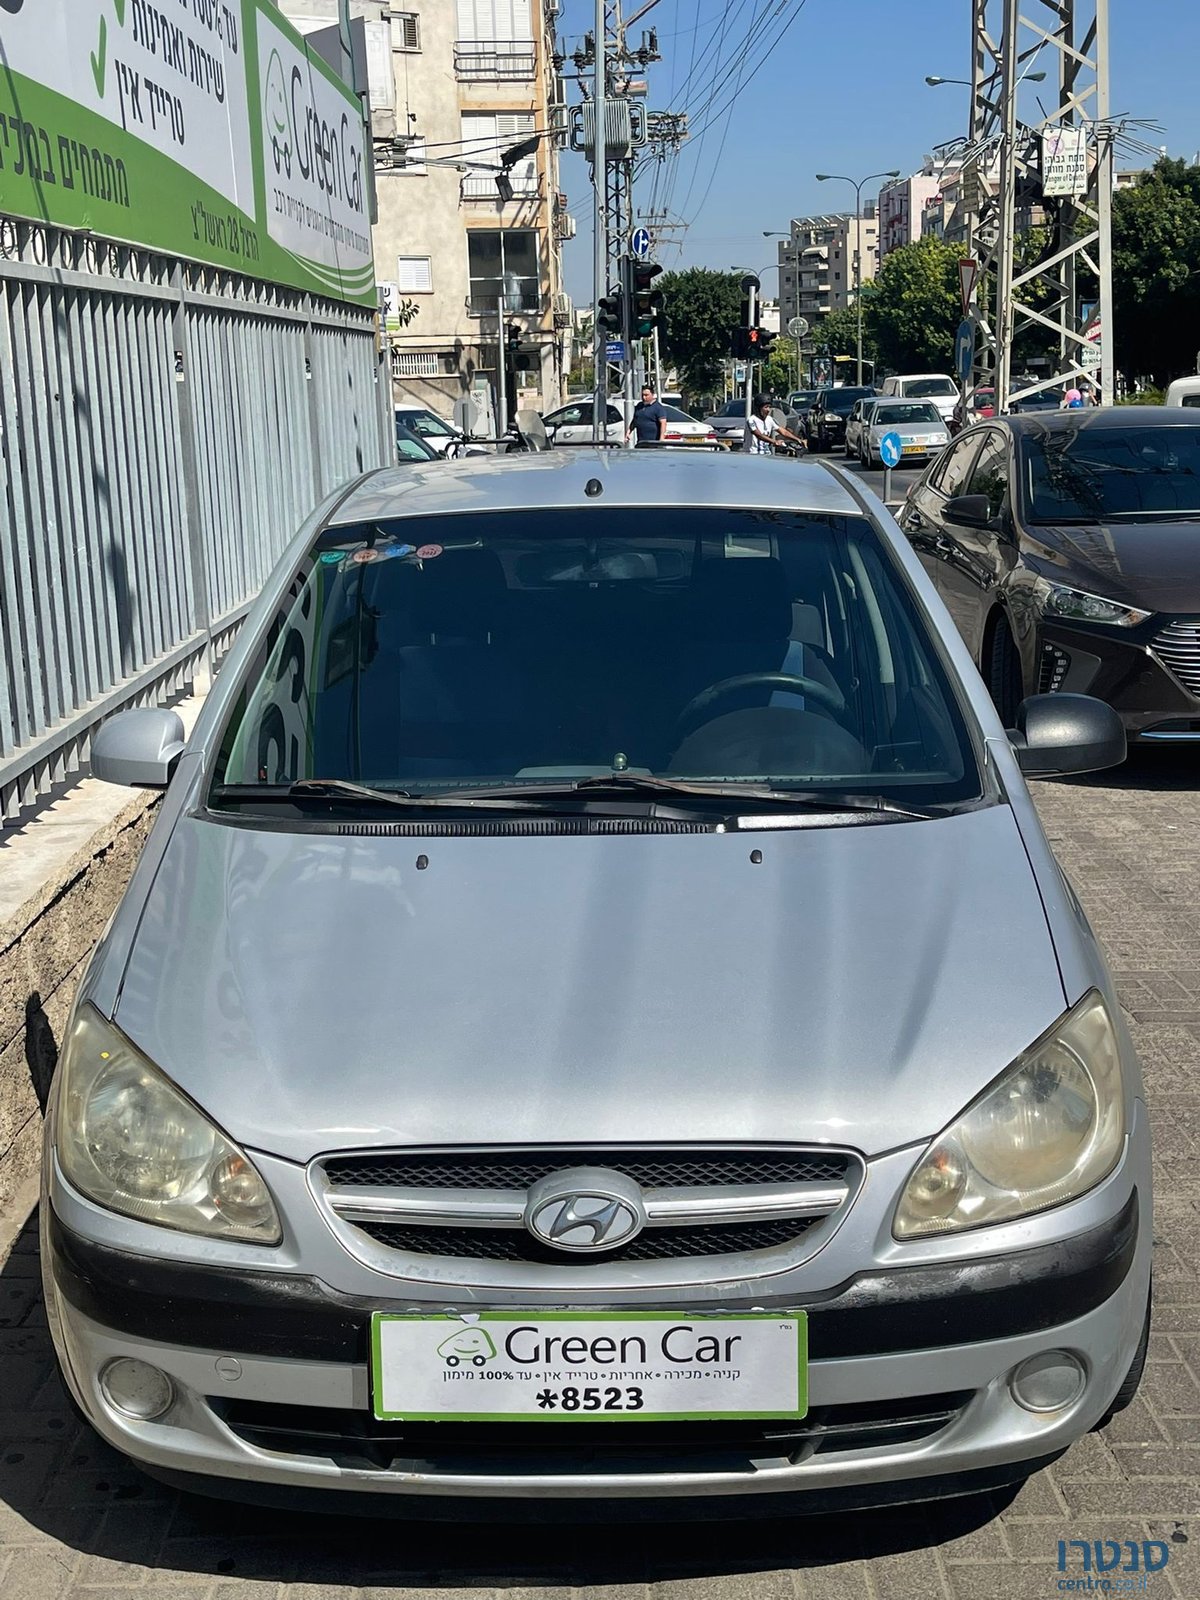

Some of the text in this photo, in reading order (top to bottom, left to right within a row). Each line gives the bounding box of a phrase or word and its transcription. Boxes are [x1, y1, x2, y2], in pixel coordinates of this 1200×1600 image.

[131, 0, 225, 104] שירות ואמינות
[114, 58, 184, 146] טרייד אין
[57, 134, 130, 208] מתמחים
[291, 65, 364, 214] Green Car
[227, 214, 240, 254] 28
[442, 1369, 741, 1382] קניה מכירה אחריות טרייד אין עד 100% מימון
[505, 1325, 742, 1364] Green Car
